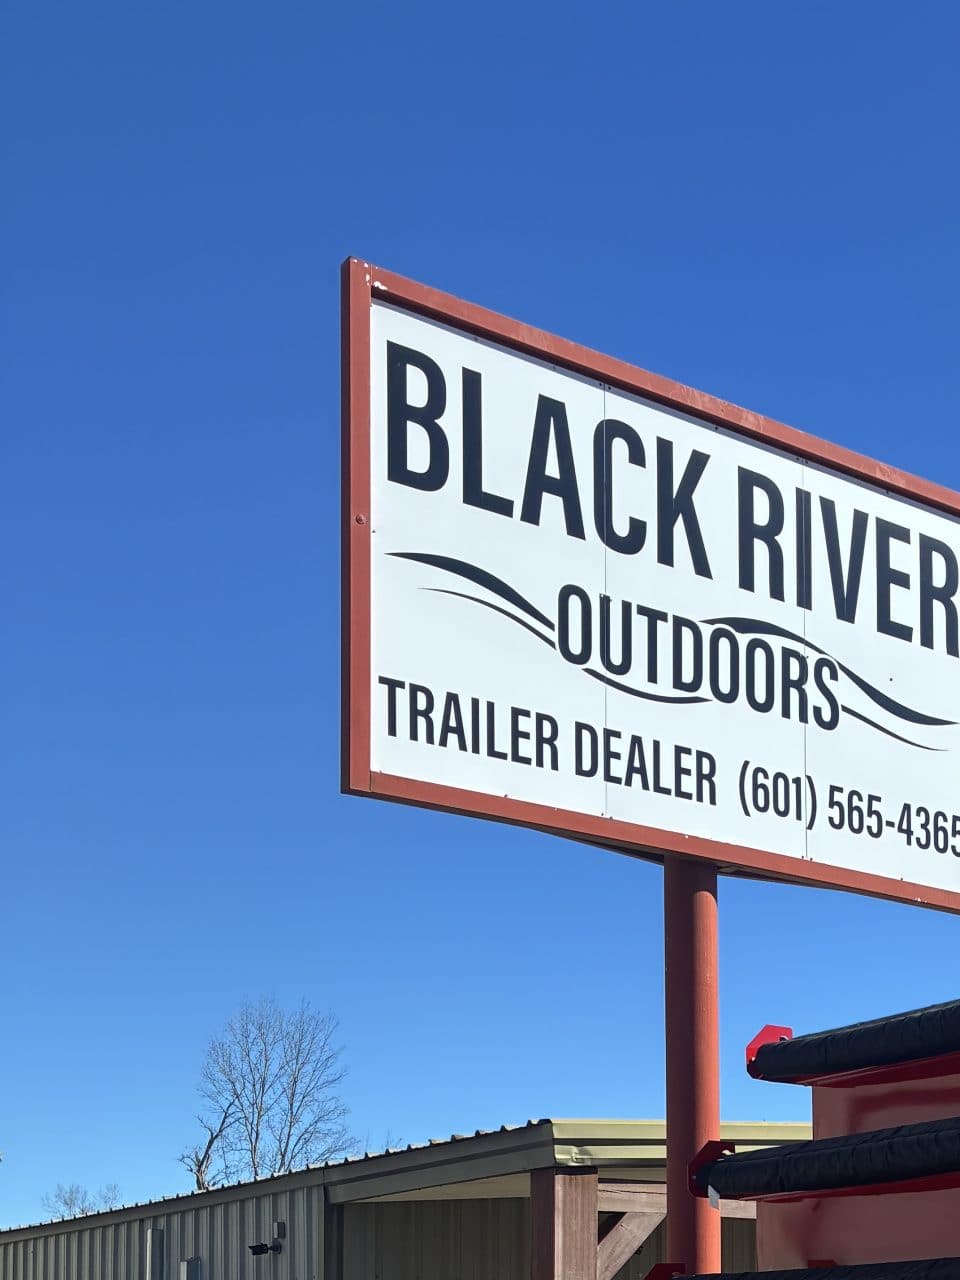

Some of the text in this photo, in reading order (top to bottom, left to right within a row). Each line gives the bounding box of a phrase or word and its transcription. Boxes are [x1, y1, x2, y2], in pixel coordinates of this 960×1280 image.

[386, 340, 960, 658] BLACK RIVER
[557, 583, 840, 731] OUTDOORS
[378, 675, 559, 772] TRAILER
[574, 721, 717, 806] DEALER
[738, 760, 817, 831] (601)
